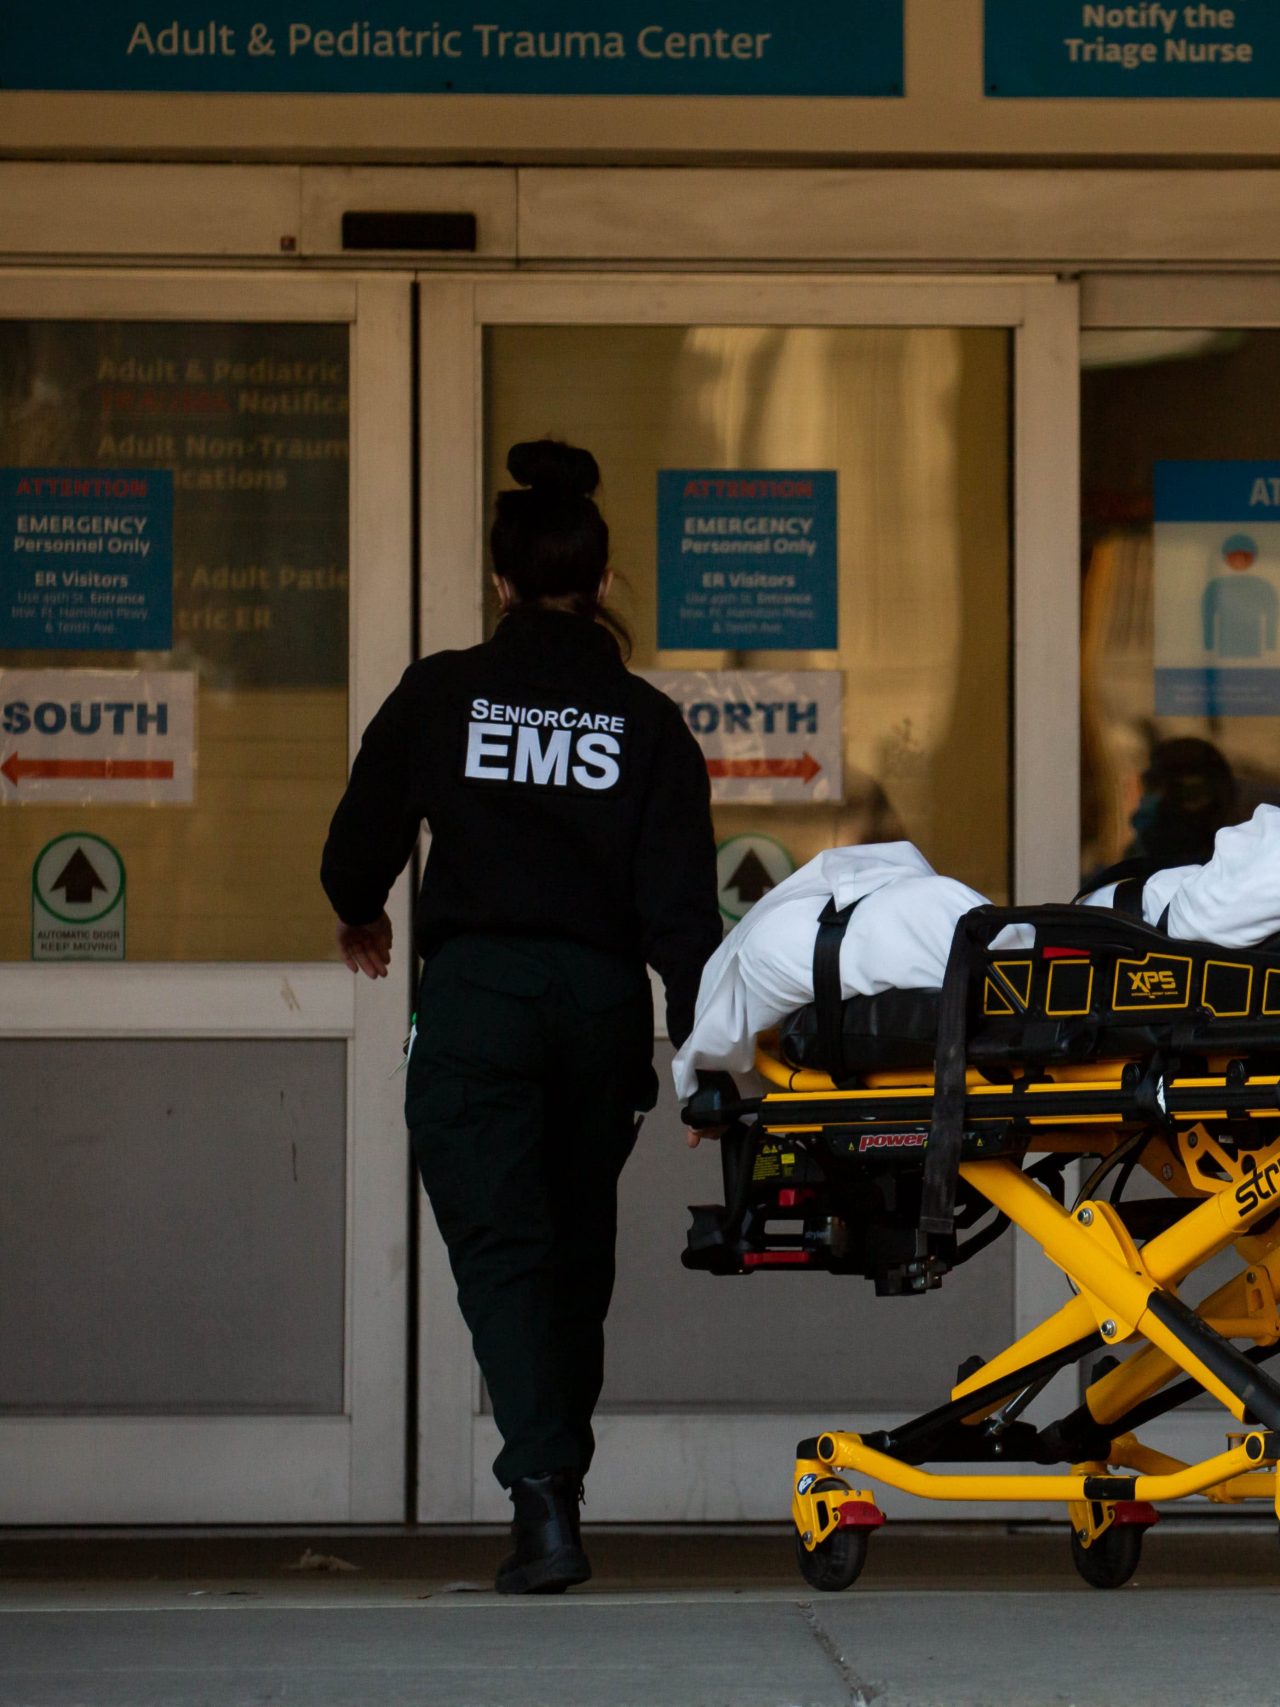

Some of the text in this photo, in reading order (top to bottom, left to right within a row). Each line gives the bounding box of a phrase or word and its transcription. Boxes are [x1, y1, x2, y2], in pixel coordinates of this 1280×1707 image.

[1082, 2, 1236, 34] Notify the
[125, 20, 772, 60] Adult & Pediatric Trauma Center
[1063, 36, 1254, 69] Triage Nurse
[97, 435, 174, 460] Adult
[15, 479, 148, 497] ATTENTION
[683, 479, 814, 497] ATTENTION
[16, 514, 148, 534] EMERGENCY
[684, 516, 814, 535] EMERGENCY
[14, 536, 151, 558] Personnel Only
[681, 537, 817, 559] Personnel Only
[34, 569, 129, 588] ER Visitors
[702, 571, 796, 589] ER Visitors
[2, 702, 169, 735] SOUTH
[677, 702, 817, 734] ORTH
[464, 721, 621, 791] EMS
[1127, 970, 1177, 993] XPS
[859, 1132, 929, 1152] power
